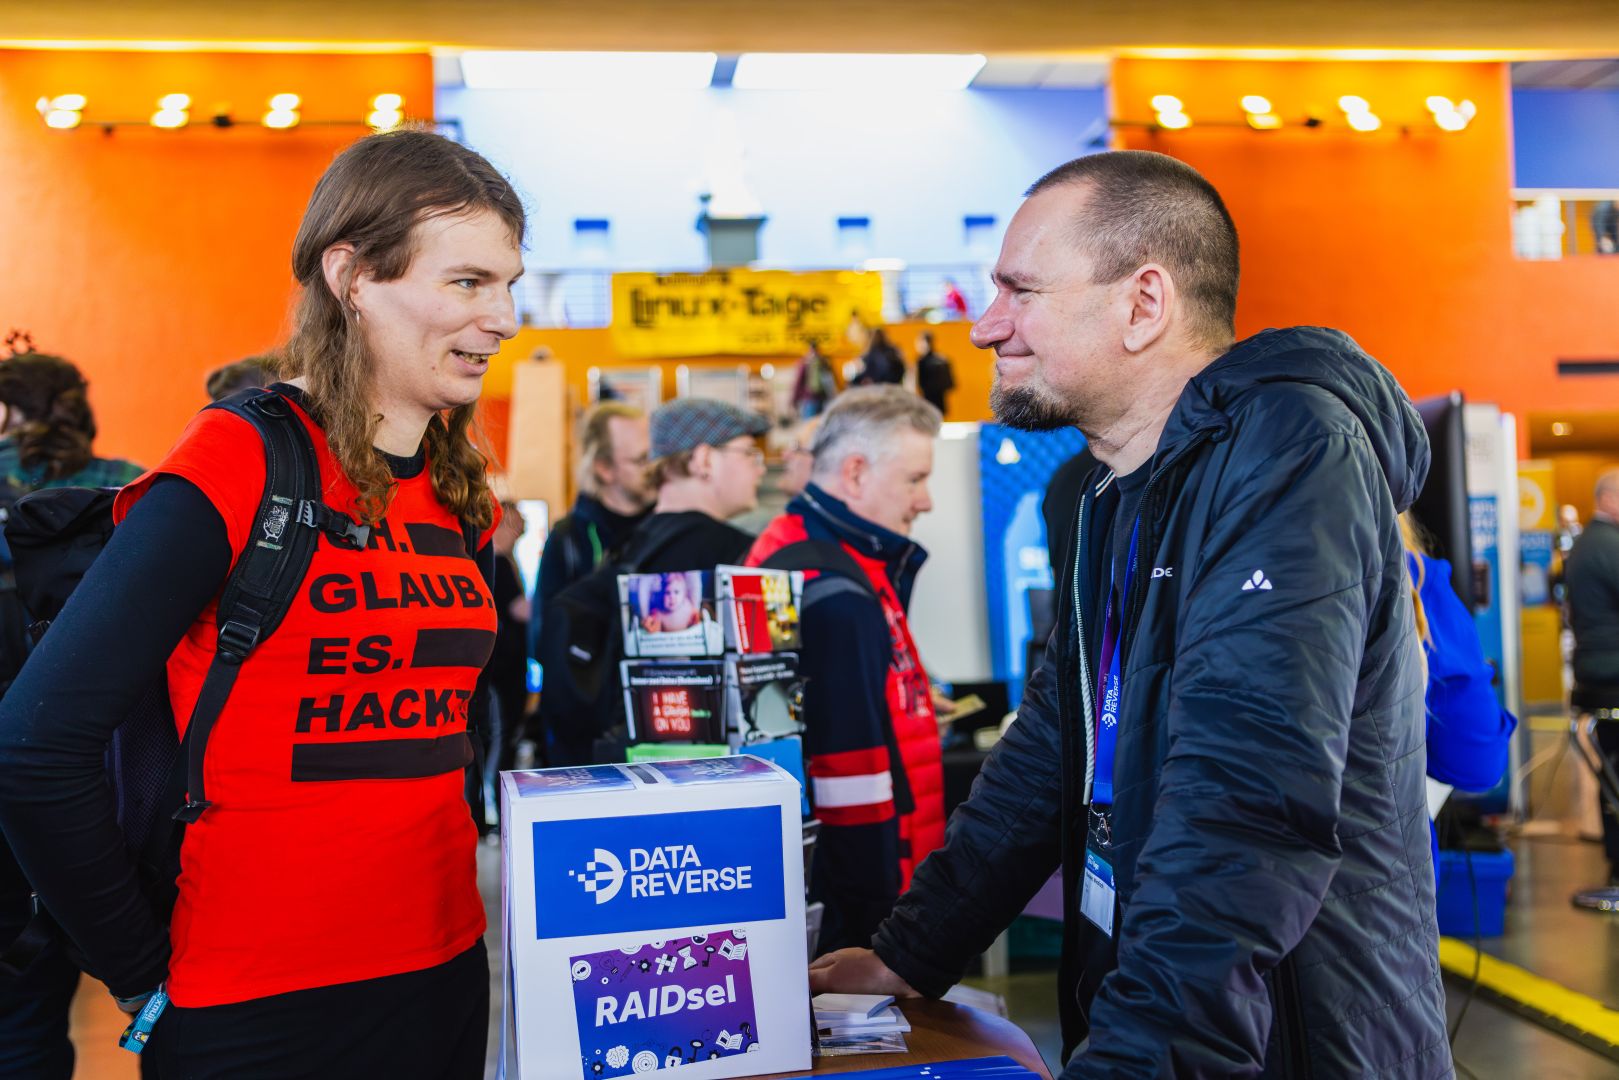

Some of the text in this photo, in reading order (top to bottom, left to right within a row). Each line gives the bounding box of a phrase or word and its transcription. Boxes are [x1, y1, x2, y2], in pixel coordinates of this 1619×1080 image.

[1150, 567, 1173, 579] DE
[309, 571, 493, 613] GLAUB.
[306, 634, 404, 675] ES.
[1104, 689, 1114, 711] DATA
[1110, 674, 1119, 713] REVERSE
[629, 845, 702, 872] DATA
[630, 865, 753, 898] REVERSE
[595, 974, 737, 1027] RAIDsel
